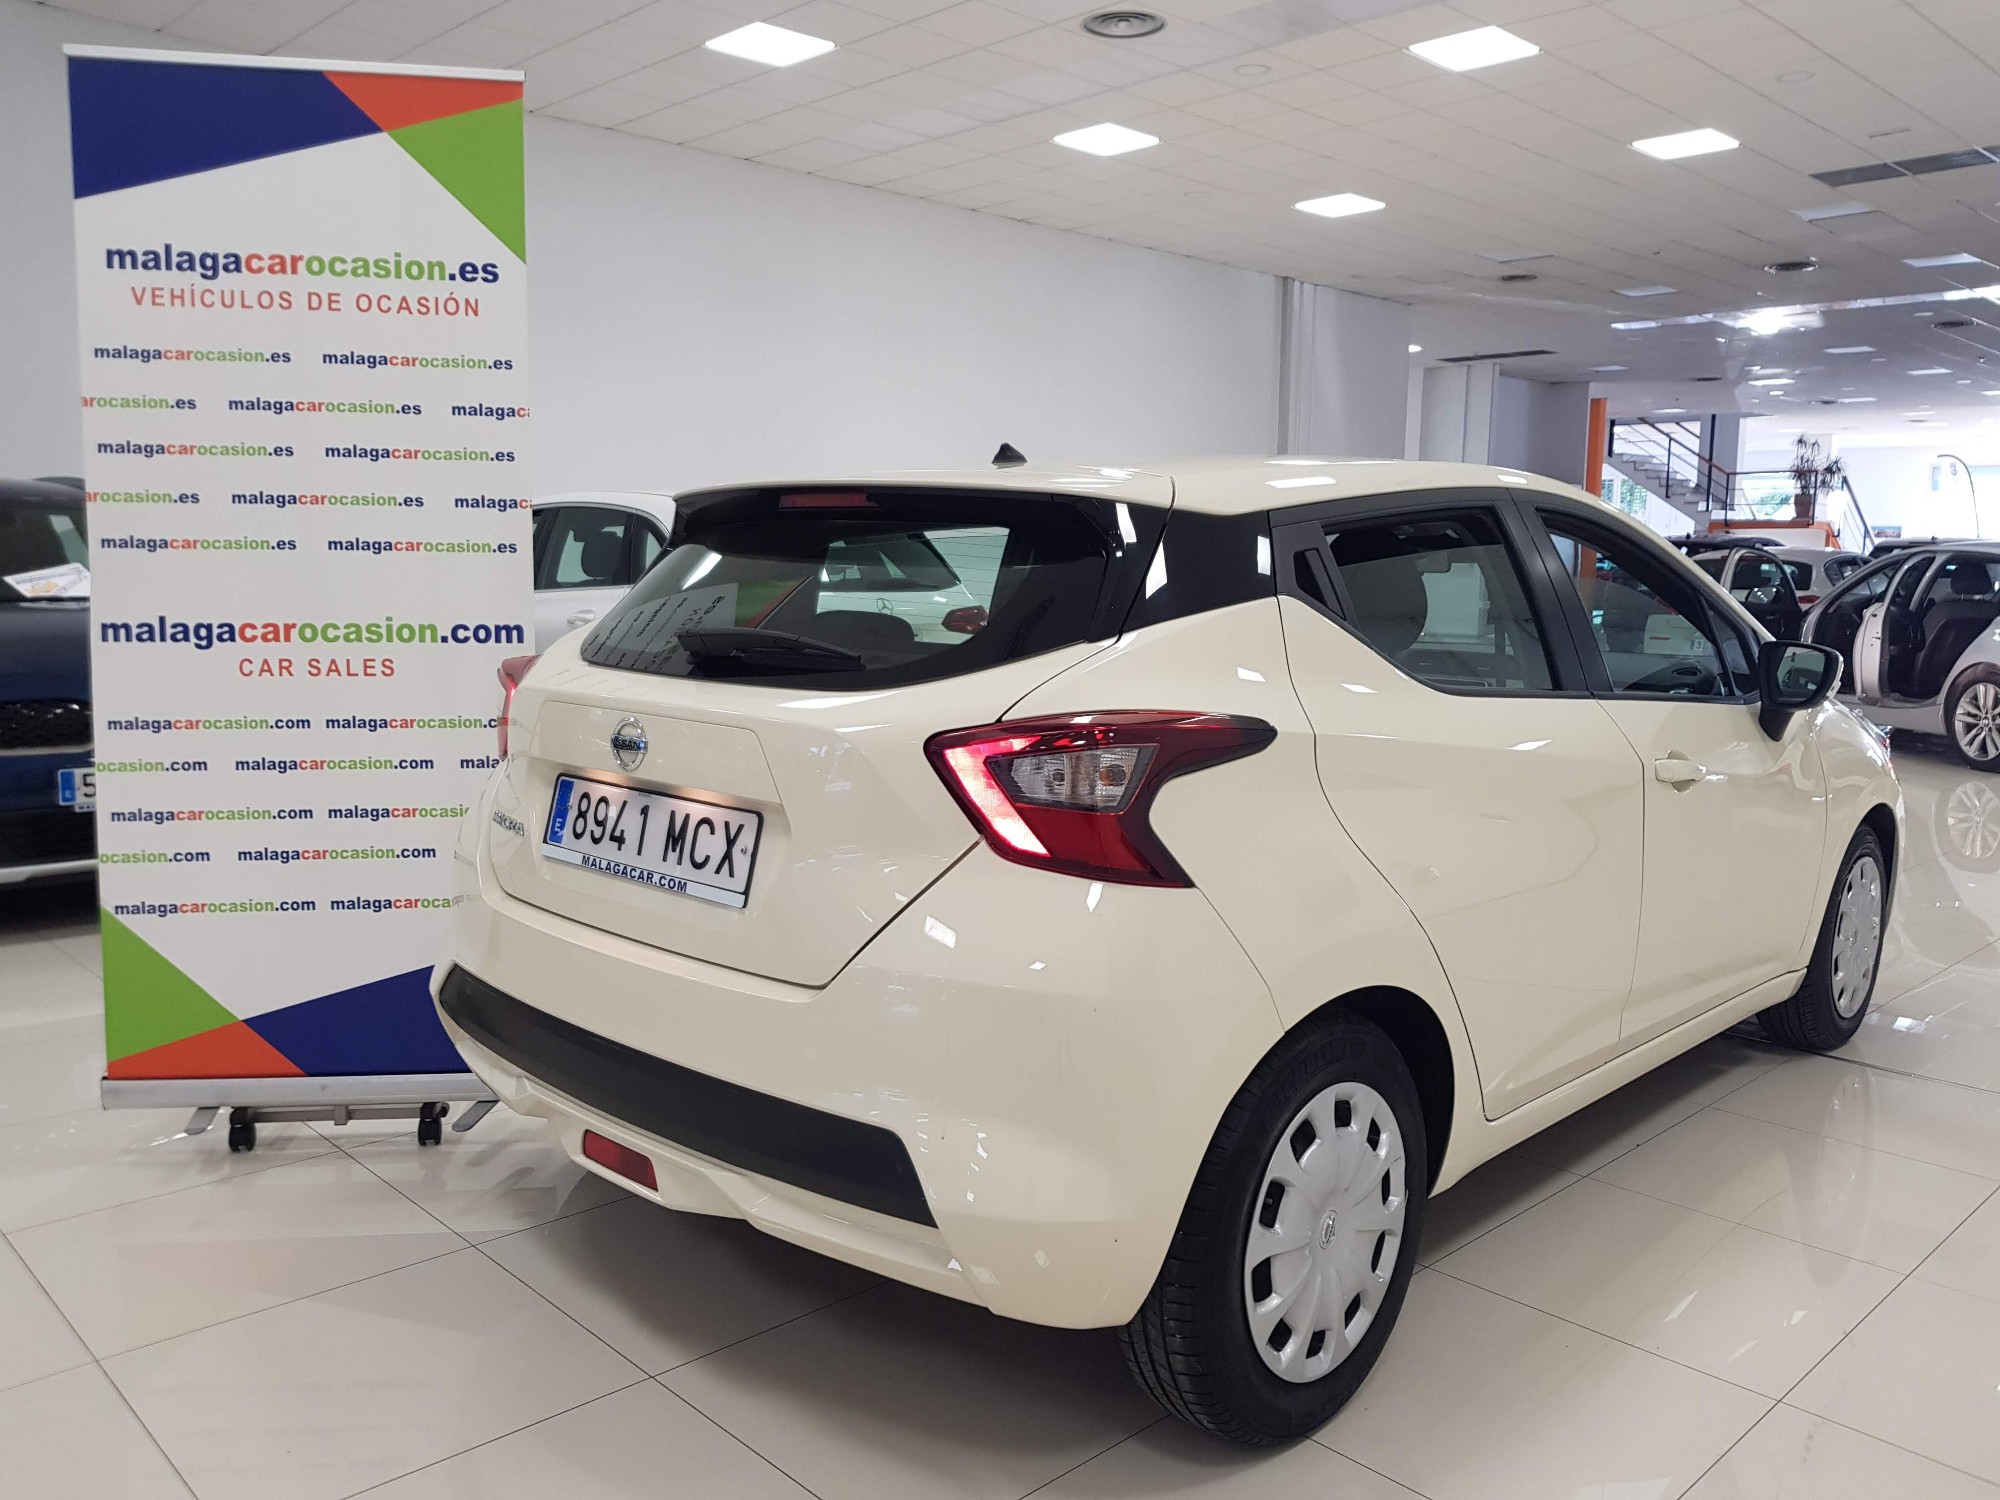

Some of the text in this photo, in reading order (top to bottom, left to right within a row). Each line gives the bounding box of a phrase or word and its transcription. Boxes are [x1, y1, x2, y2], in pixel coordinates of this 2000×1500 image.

[106, 243, 499, 284] malagacarocasion.es
[131, 284, 478, 316] VEHÍCULOS DE OCASIÓN
[94, 345, 291, 363] malagacarocasion.es
[323, 351, 513, 370] malagacarocasion.es
[229, 397, 422, 415] malagacarocasion.es
[452, 403, 530, 421] malagac
[98, 440, 294, 458] malagacarocasion.es
[325, 444, 515, 462] malagacarocasion.es
[232, 491, 424, 508] malagacarocasion.es
[101, 535, 296, 552] malagacarocasion.es
[328, 537, 517, 555] malagacarocasion.es
[101, 615, 524, 650] malagacarocasion.com
[239, 658, 394, 677] CAR SALES
[107, 716, 311, 733] malagacarocasion.com
[96, 759, 208, 772] ocasion.com
[235, 757, 434, 774] malagacarocasion.com
[111, 807, 313, 825] malagacarocasion.com
[572, 792, 745, 878] 8941 MCX
[238, 846, 436, 864] malagacarocasion.com
[581, 855, 688, 893] MALAGACAR.COM
[114, 899, 316, 916] malagacarocasion.com
